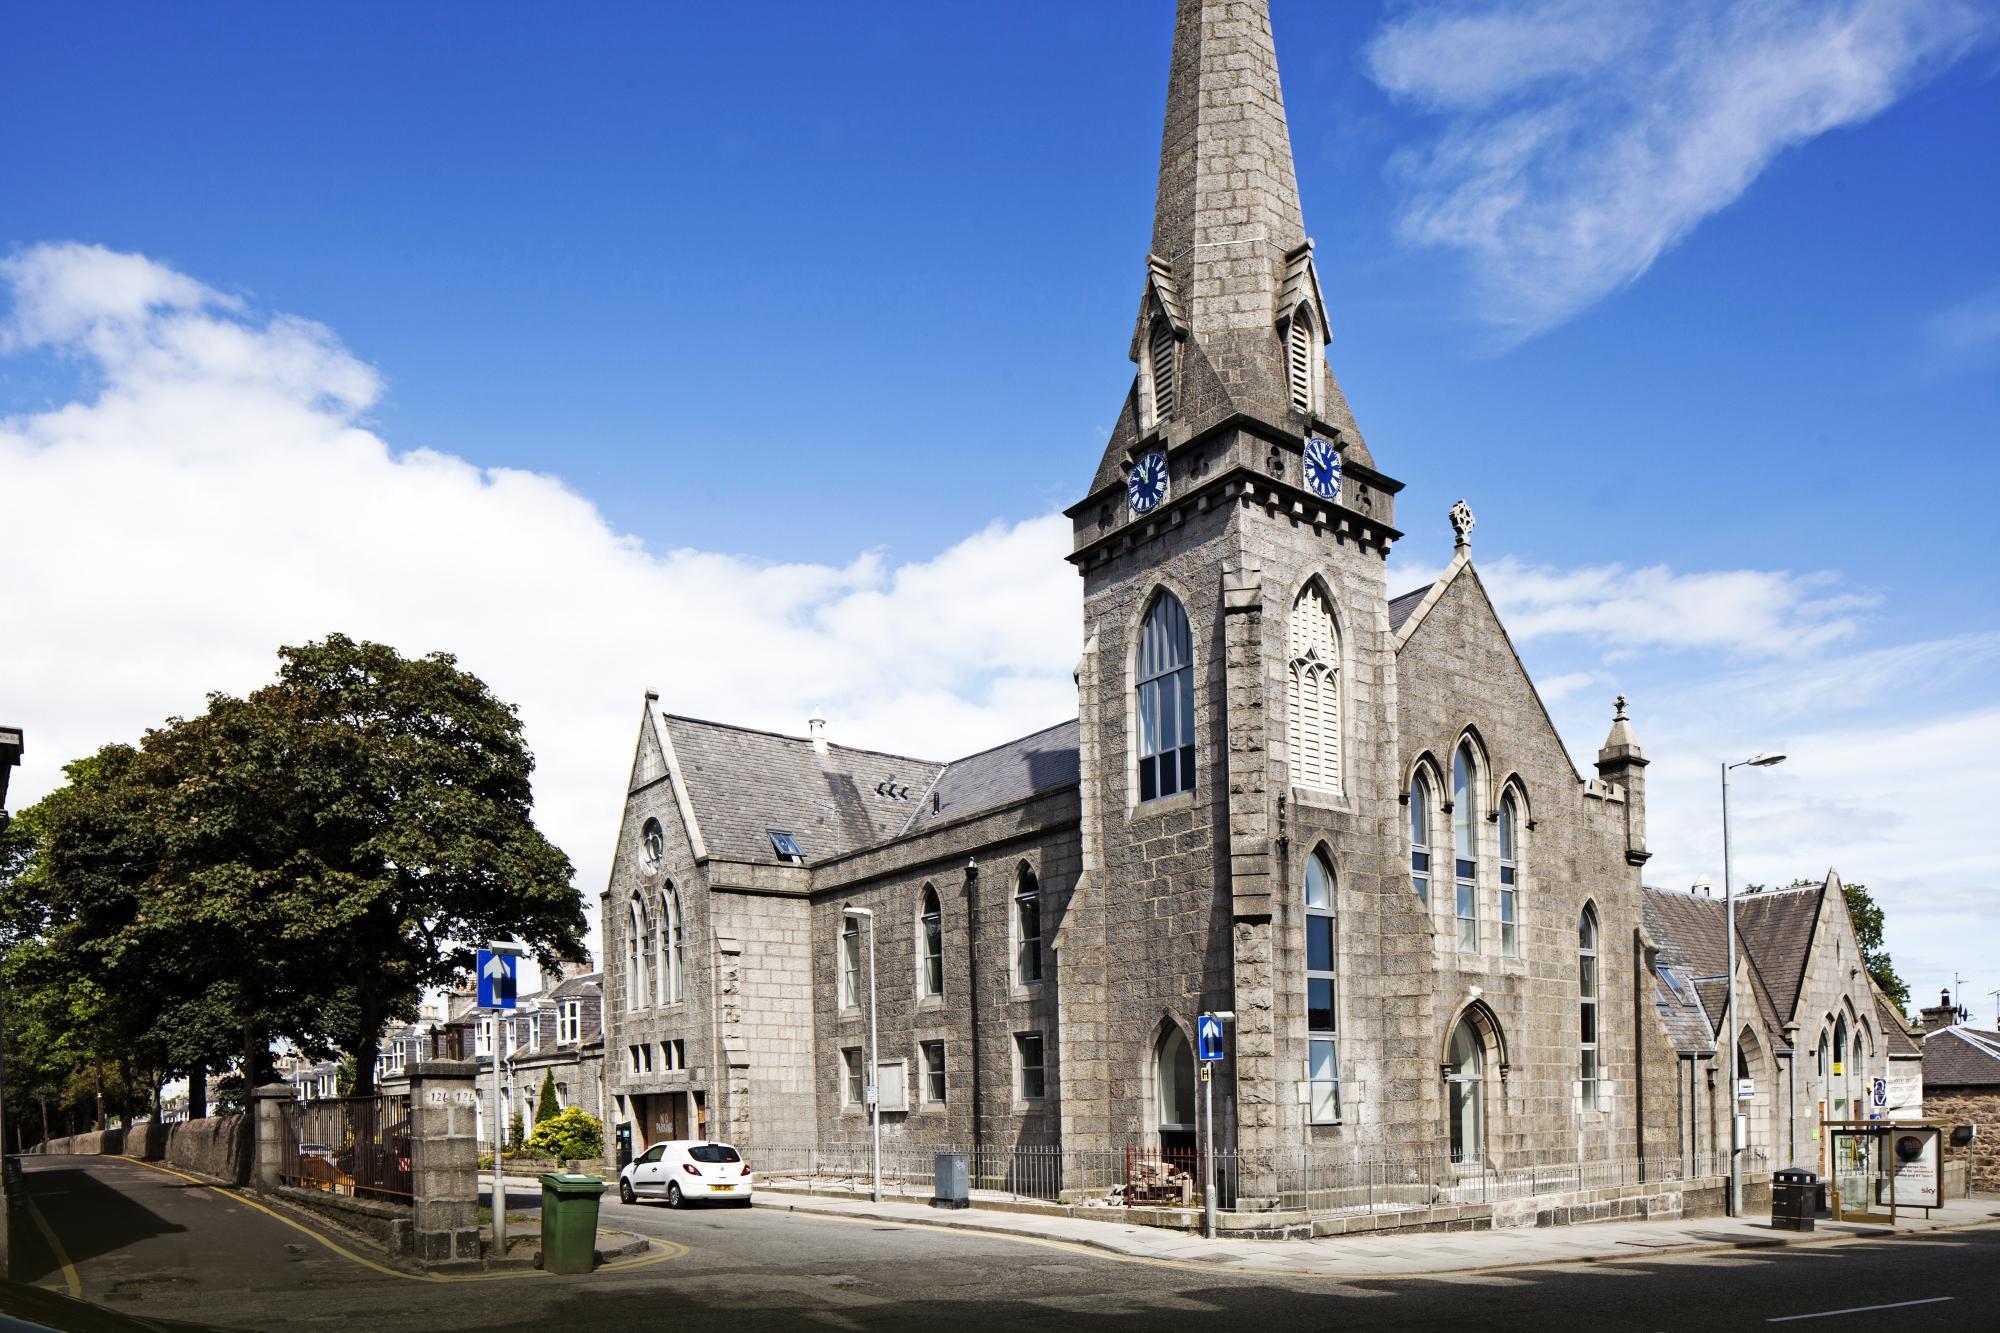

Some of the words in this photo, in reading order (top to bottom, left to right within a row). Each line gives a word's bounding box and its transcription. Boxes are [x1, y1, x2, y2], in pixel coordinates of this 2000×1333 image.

[1202, 1069, 1209, 1079] H
[432, 1093, 448, 1102] 126
[1921, 1187, 1936, 1195] sky
